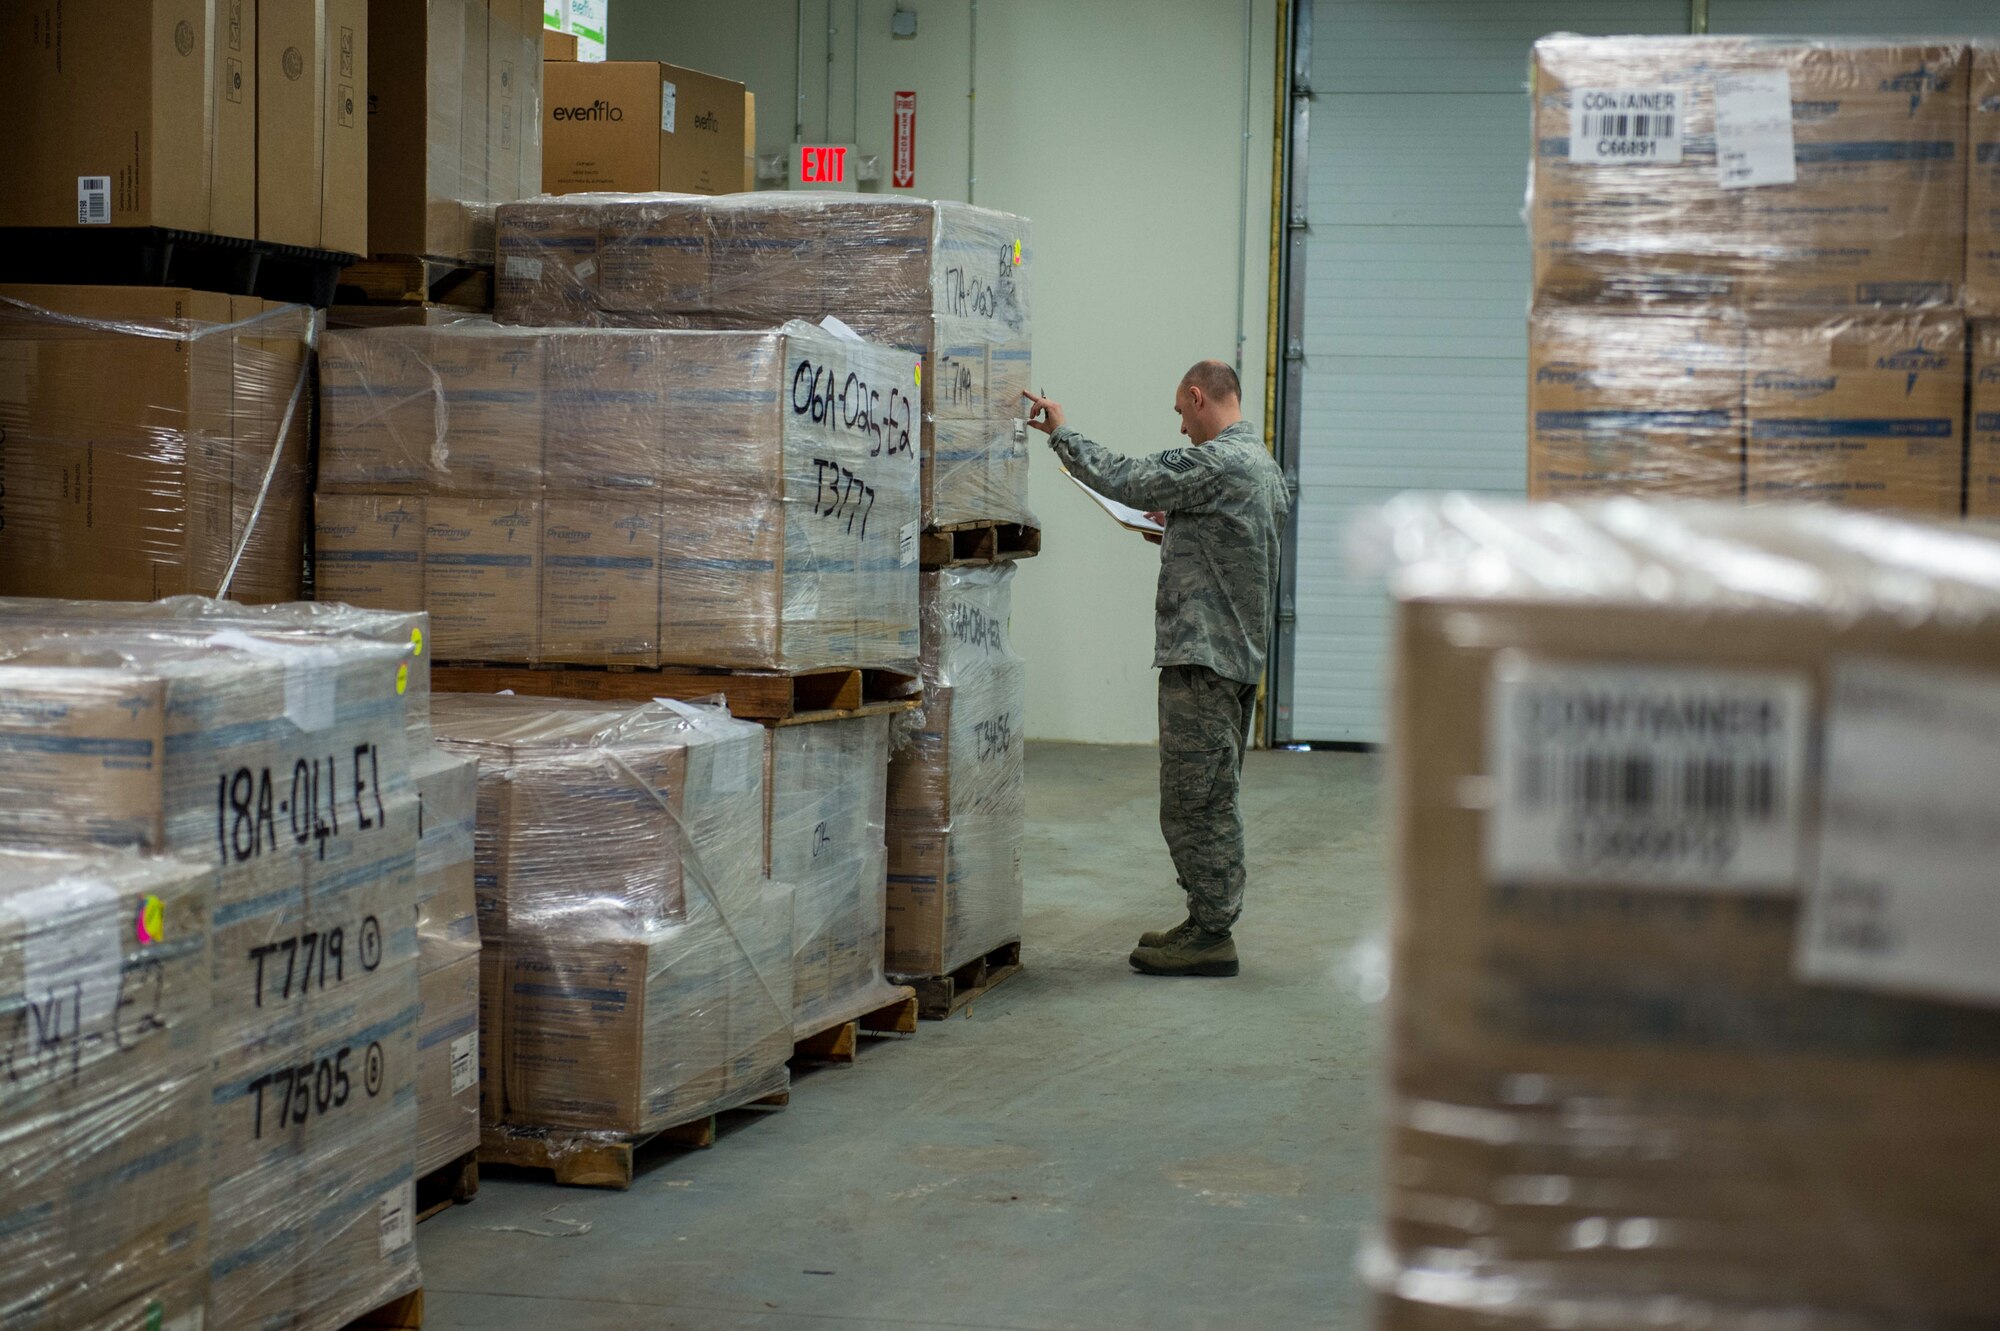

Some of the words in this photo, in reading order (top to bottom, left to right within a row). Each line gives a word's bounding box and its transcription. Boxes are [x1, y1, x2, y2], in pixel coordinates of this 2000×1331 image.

[553, 100, 623, 122] evenflo
[1583, 92, 1675, 111] CONTAINER
[899, 112, 909, 181] EXTINGUISHER
[801, 147, 847, 182] EXIT
[79, 199, 88, 224] 3712198
[793, 360, 914, 460] 06A-025-E2
[813, 458, 875, 542] T3777
[426, 526, 472, 538] Proxima
[547, 528, 592, 540] Proxima
[249, 926, 344, 1009] T7719
[248, 1046, 352, 1140] T7505
